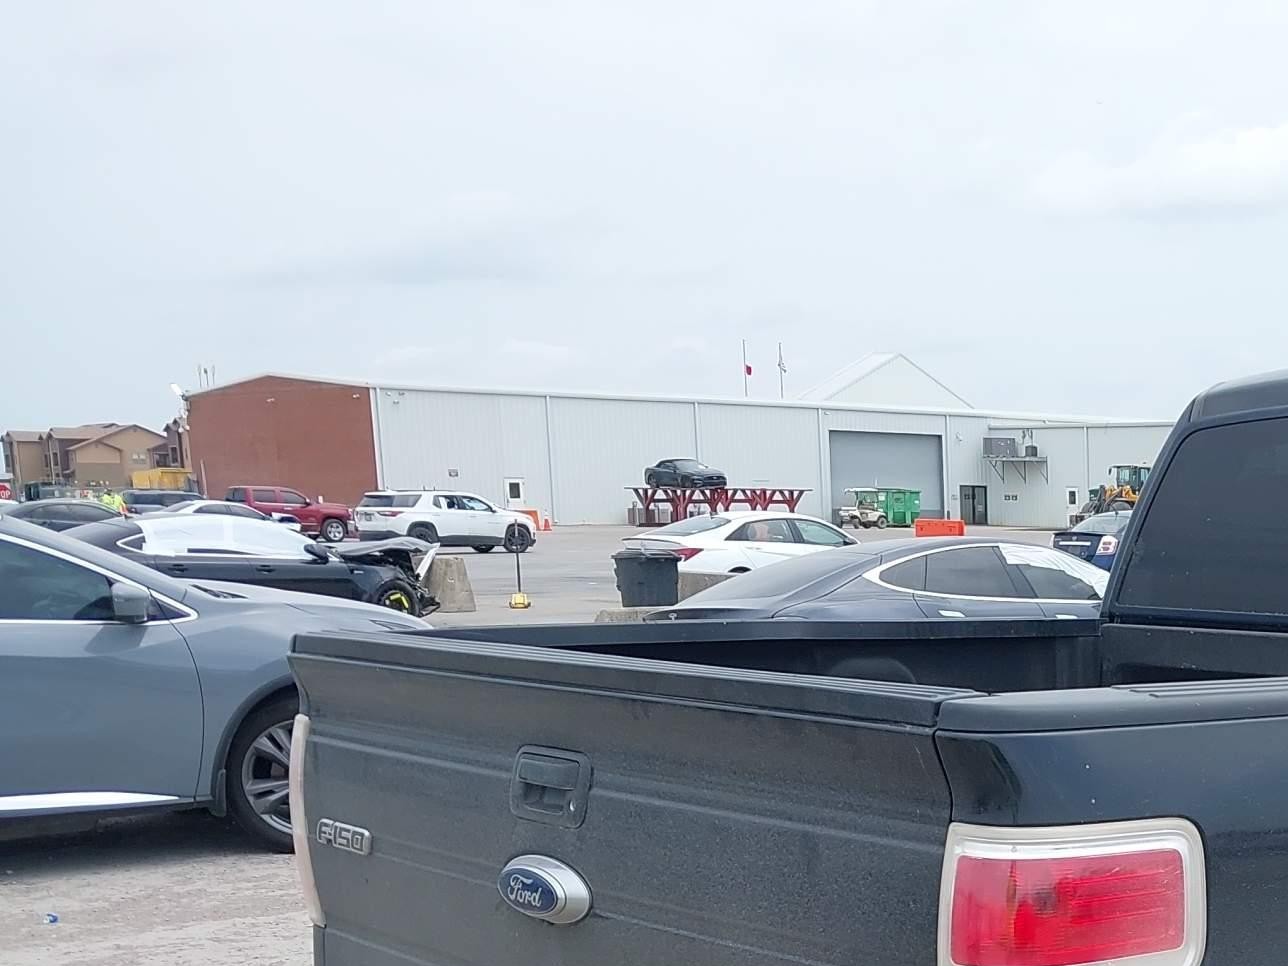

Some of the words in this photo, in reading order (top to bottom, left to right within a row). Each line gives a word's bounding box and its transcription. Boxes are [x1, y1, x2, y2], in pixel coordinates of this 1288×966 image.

[0, 490, 11, 499] OP
[317, 818, 372, 856] F-150
[507, 873, 543, 908] Ford
